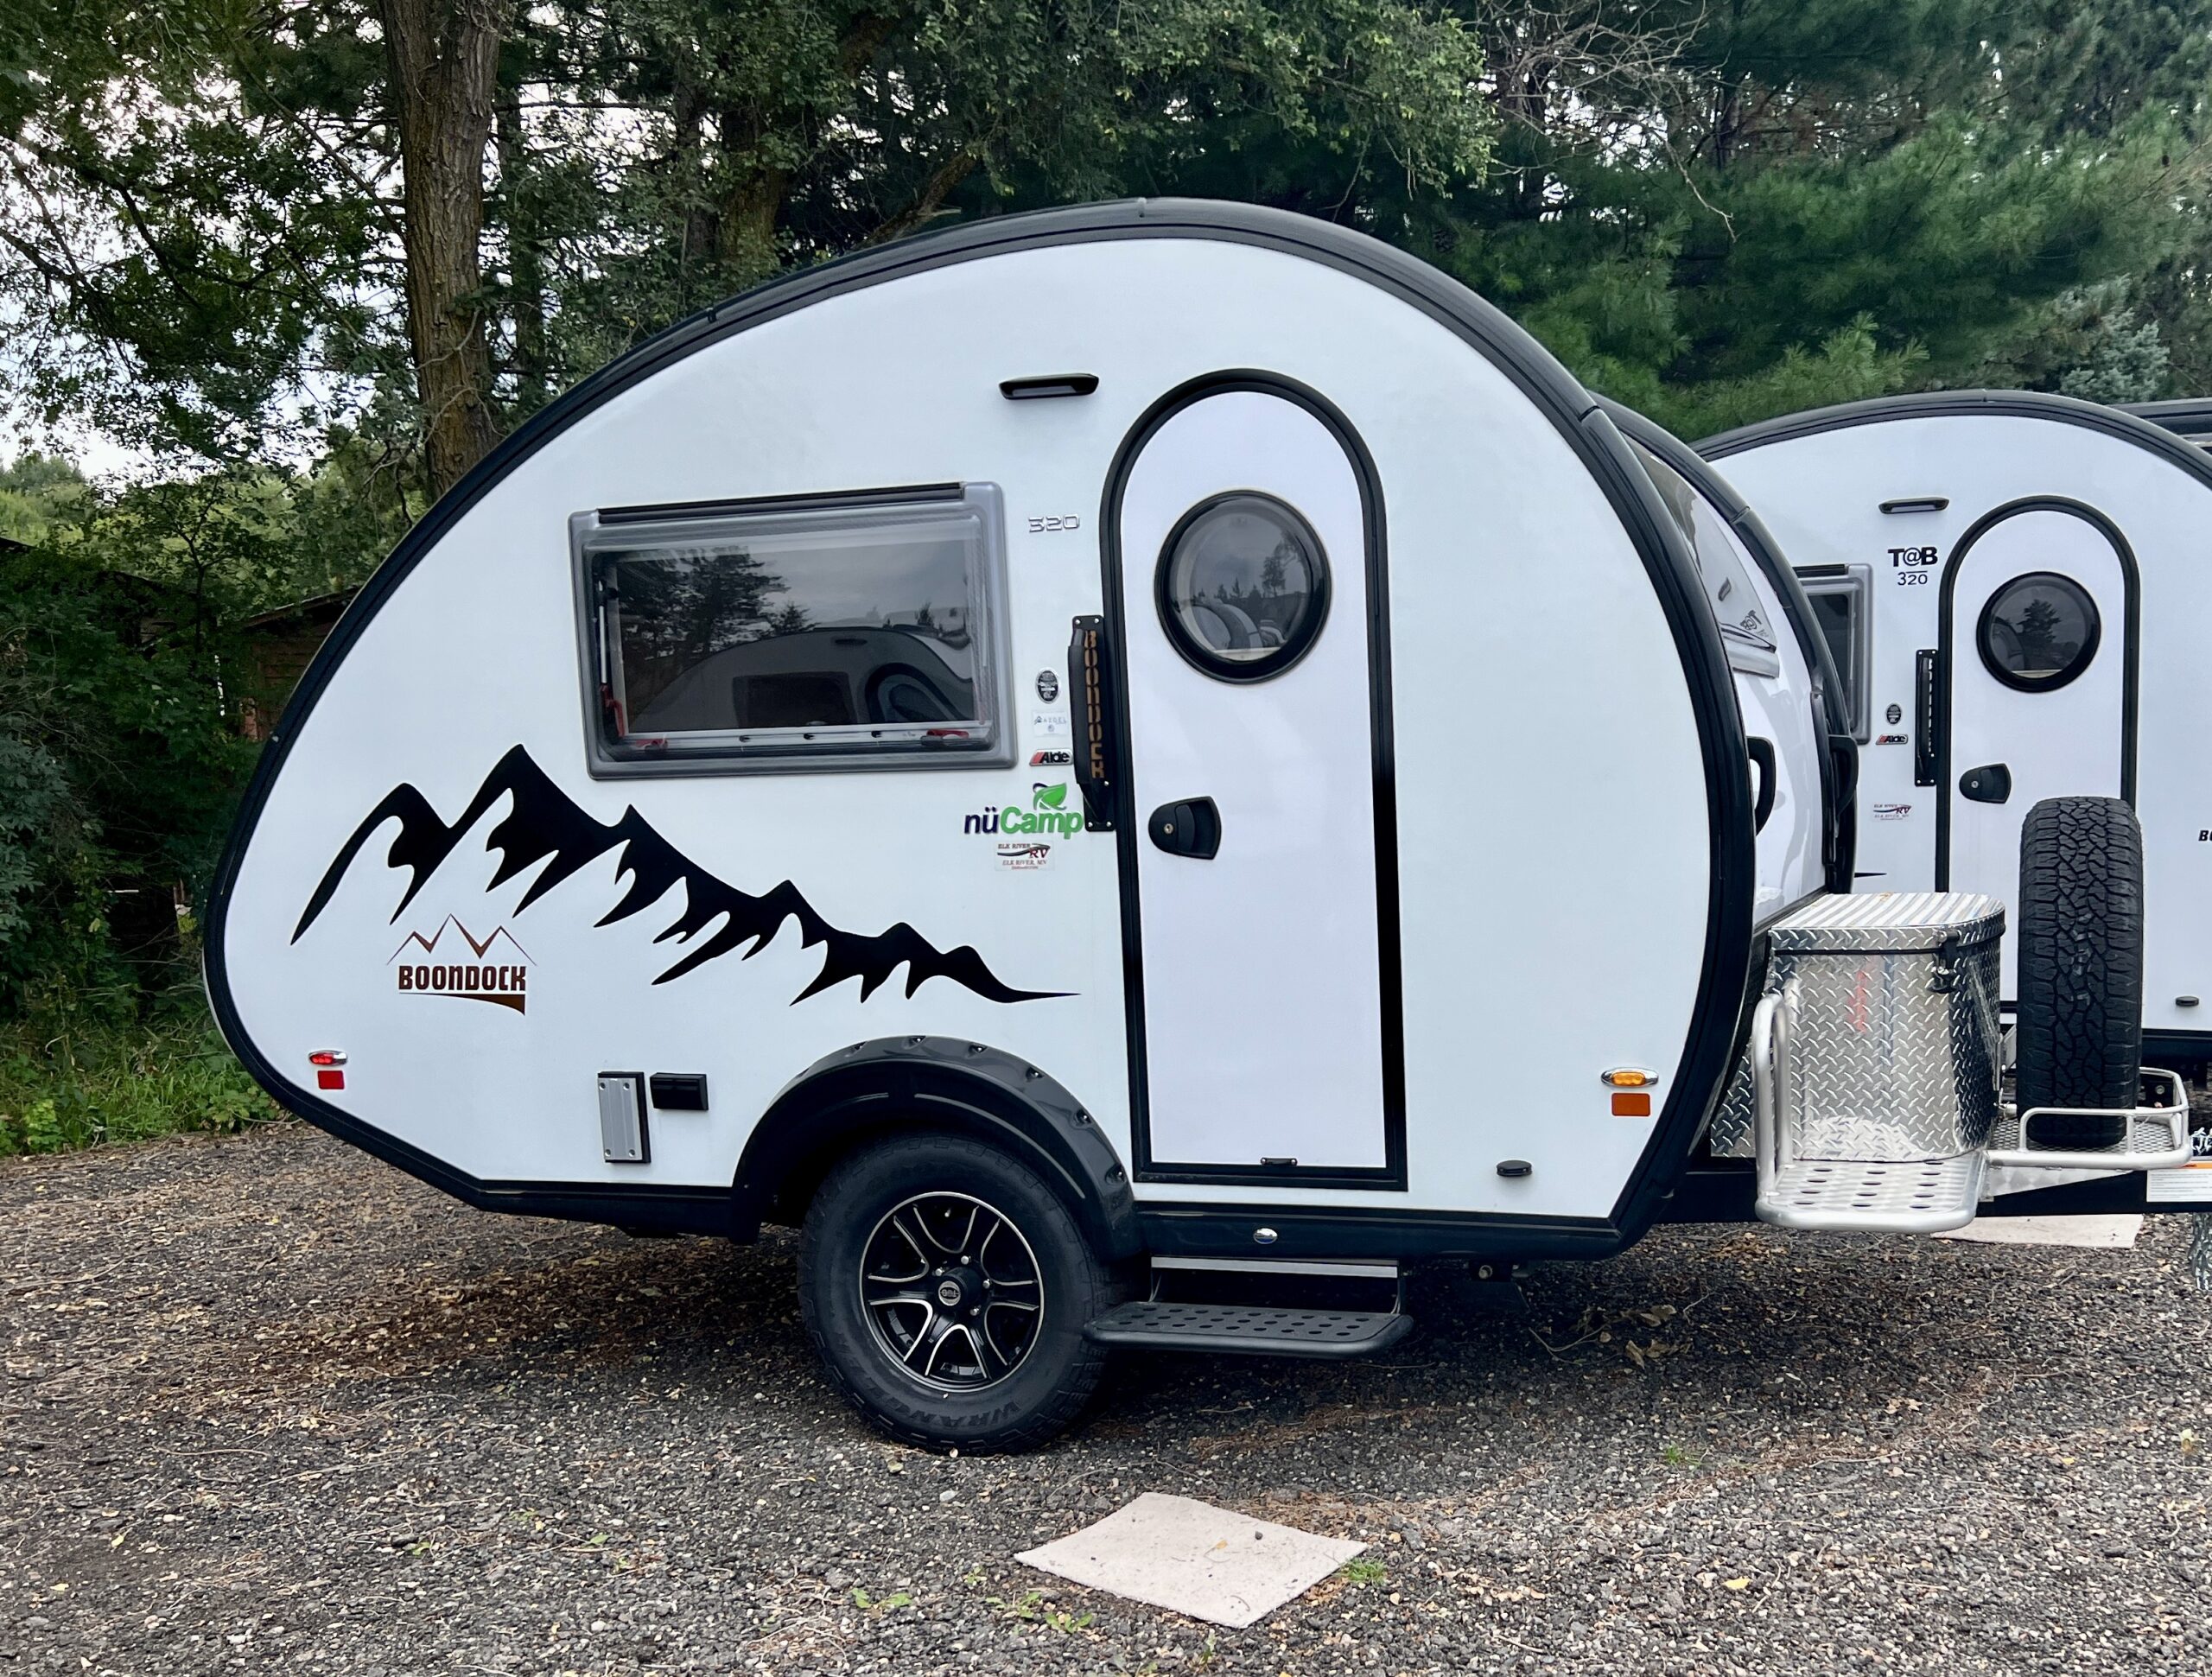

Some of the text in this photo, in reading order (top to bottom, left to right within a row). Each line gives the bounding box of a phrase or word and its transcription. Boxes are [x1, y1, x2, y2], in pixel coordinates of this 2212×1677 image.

[1028, 514, 1080, 533] 320
[1887, 546, 1938, 567] T@B
[1897, 572, 1928, 586] 320
[1040, 751, 1071, 763] Alde
[964, 806, 1084, 840] nüCamp
[1029, 848, 1050, 858] RV
[398, 965, 527, 991] BOONDOCK
